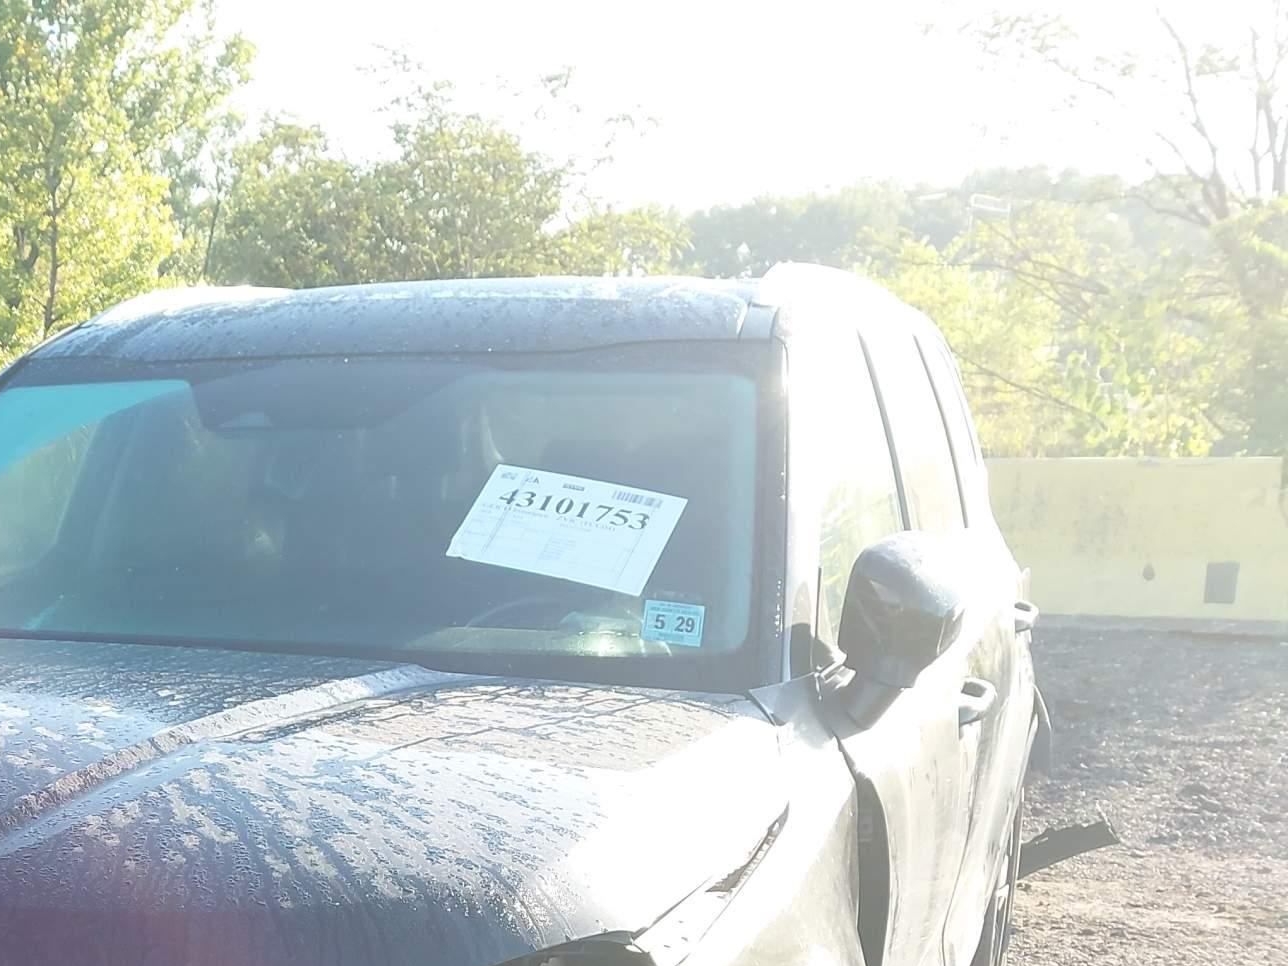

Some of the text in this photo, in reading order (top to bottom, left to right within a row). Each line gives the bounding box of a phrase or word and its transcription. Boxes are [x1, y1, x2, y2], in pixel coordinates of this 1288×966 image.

[499, 488, 650, 531] 43101753
[654, 613, 696, 633] 5 29
